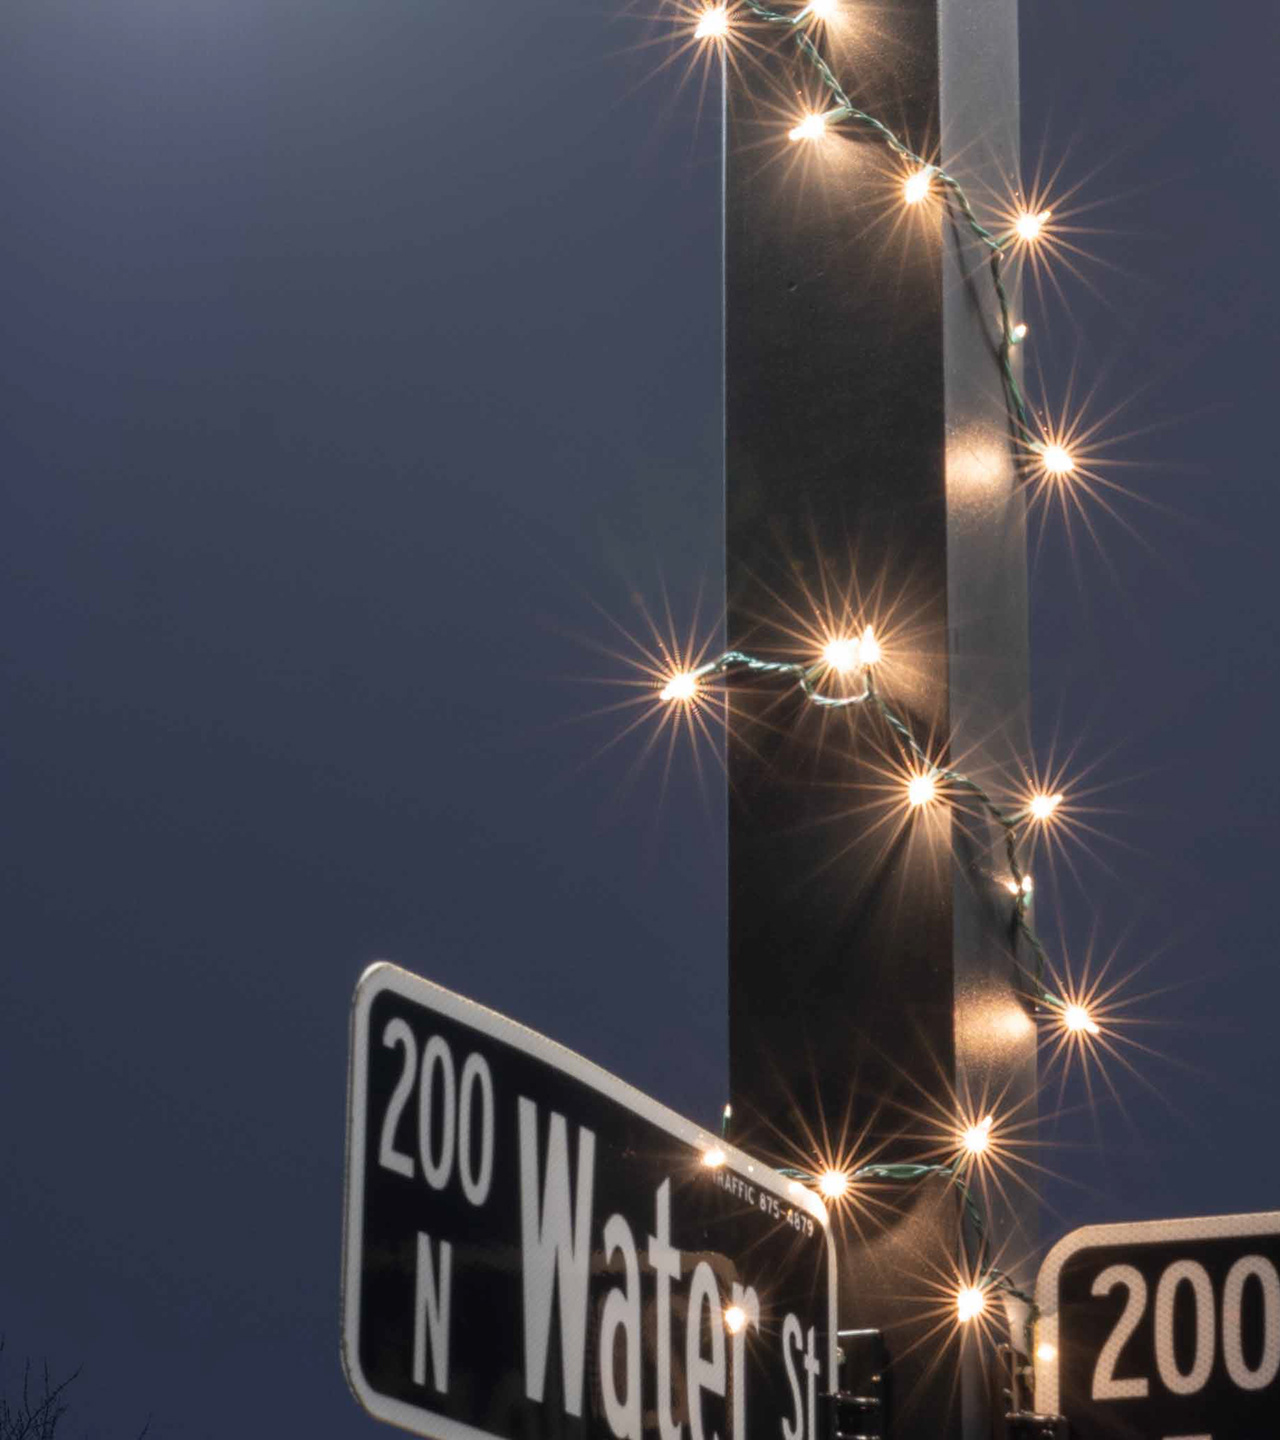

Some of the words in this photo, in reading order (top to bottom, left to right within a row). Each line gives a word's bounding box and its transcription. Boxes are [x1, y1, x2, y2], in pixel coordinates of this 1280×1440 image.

[378, 1017, 495, 1207] 200
[712, 1170, 756, 1206] TRAFFIC
[413, 1230, 453, 1395] N
